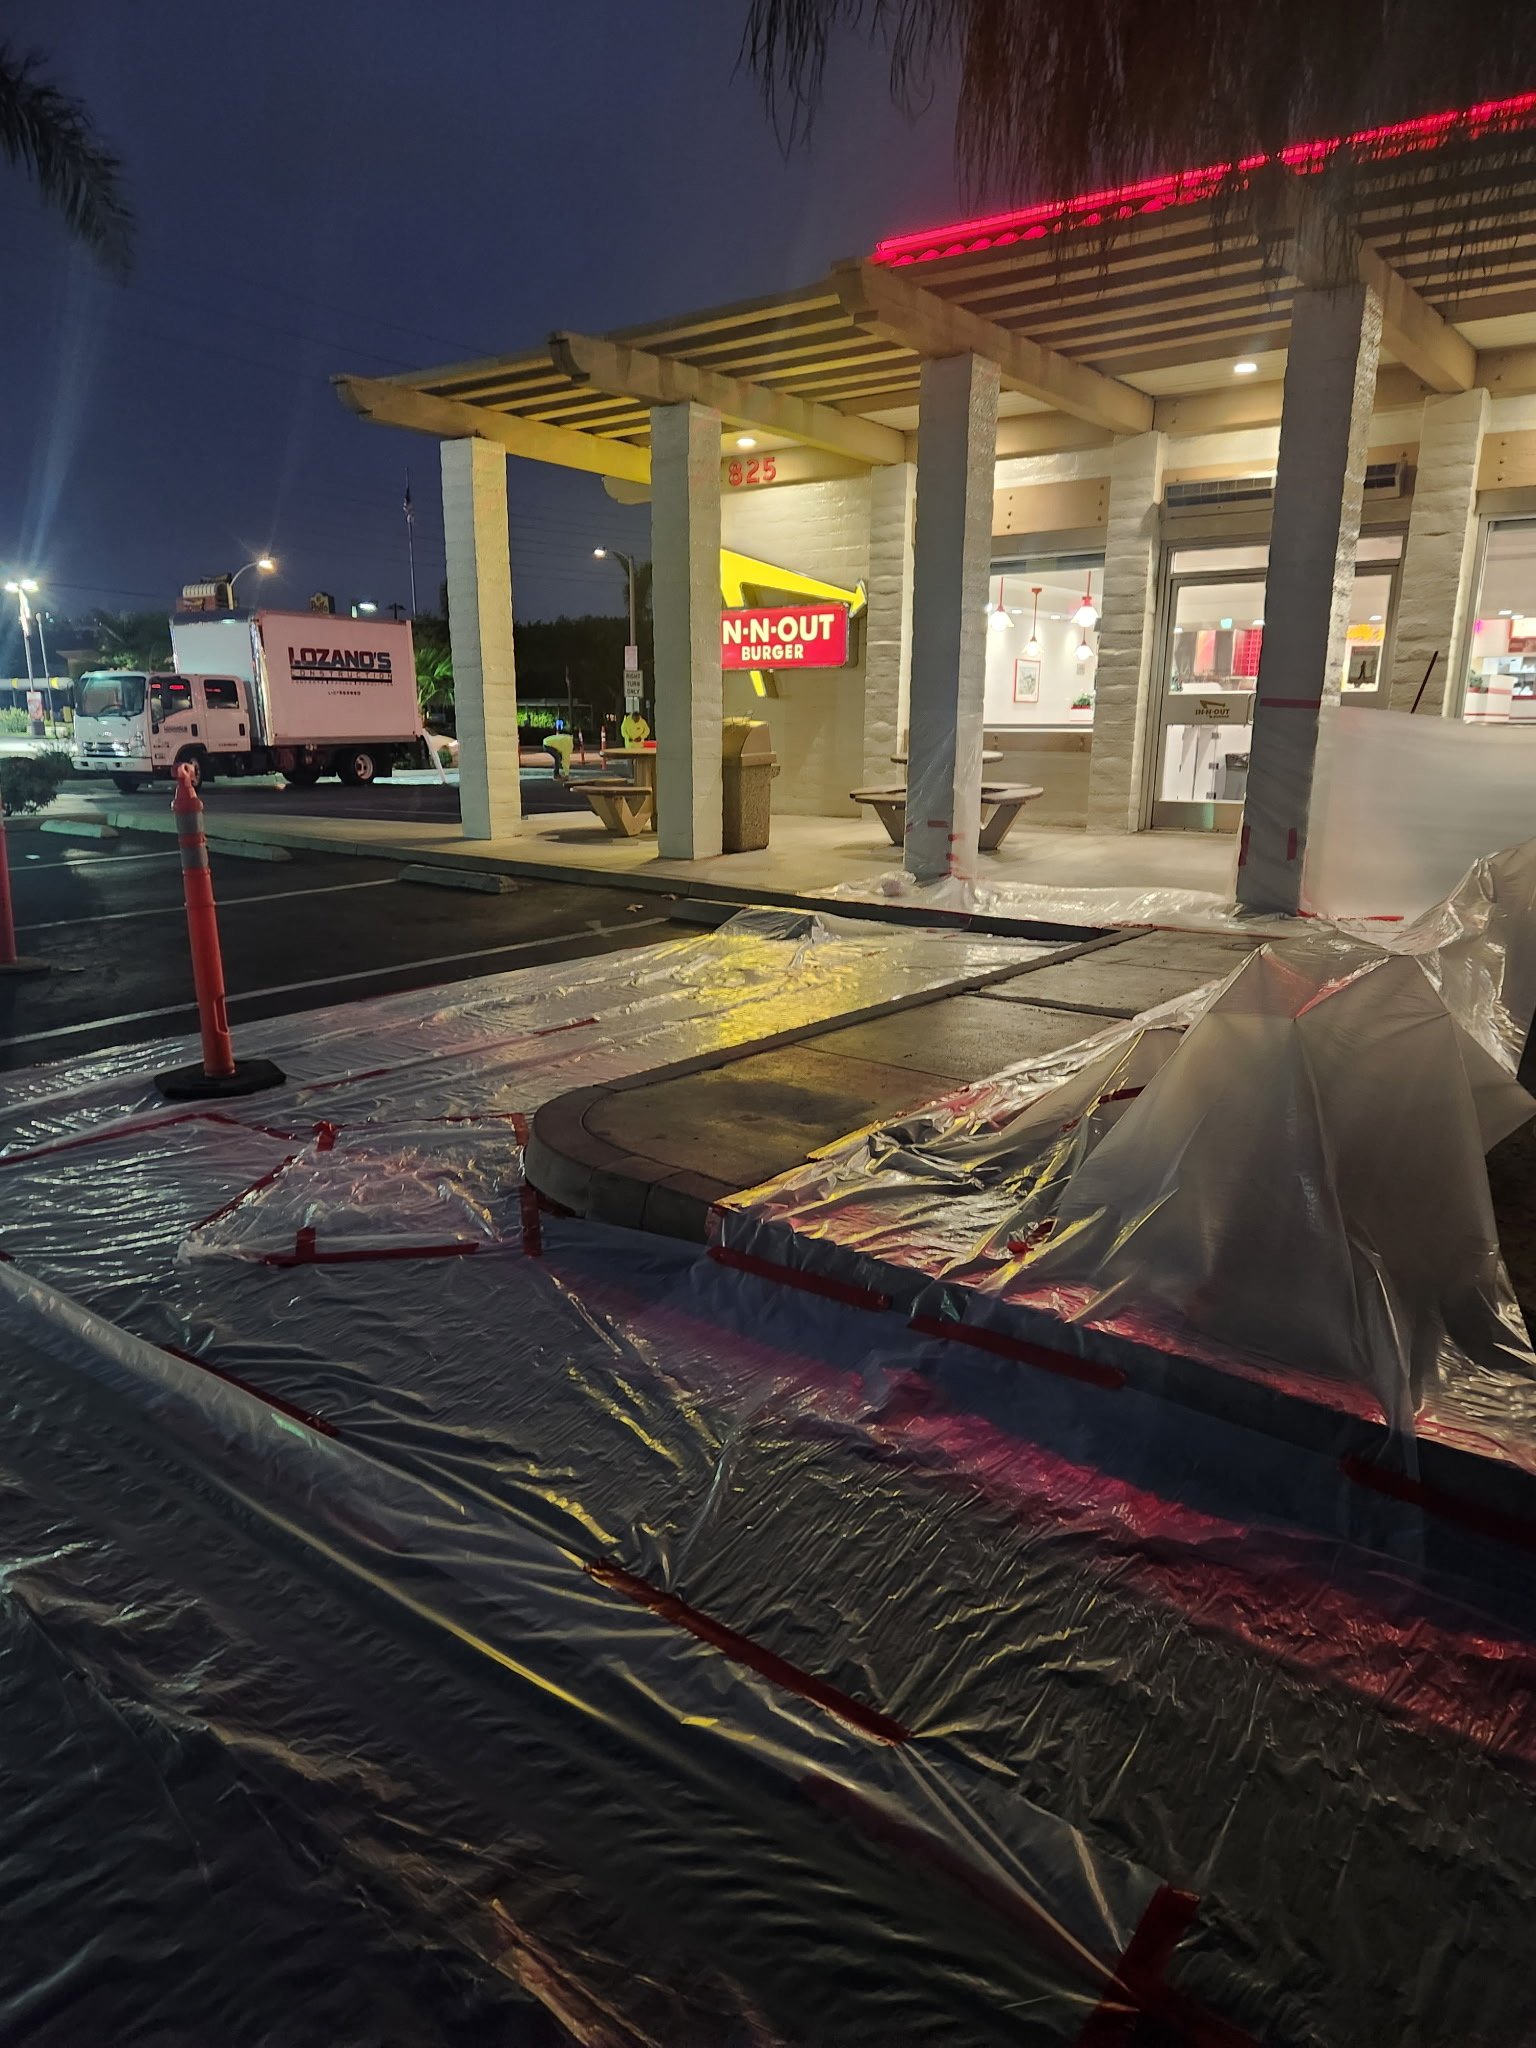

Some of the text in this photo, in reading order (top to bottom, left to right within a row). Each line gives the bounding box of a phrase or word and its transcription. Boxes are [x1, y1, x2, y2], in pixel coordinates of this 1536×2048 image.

[729, 457, 777, 487] 825
[722, 613, 835, 645] N-N-OUT
[288, 647, 392, 669] LOZANO'S
[741, 643, 804, 661] BURGER
